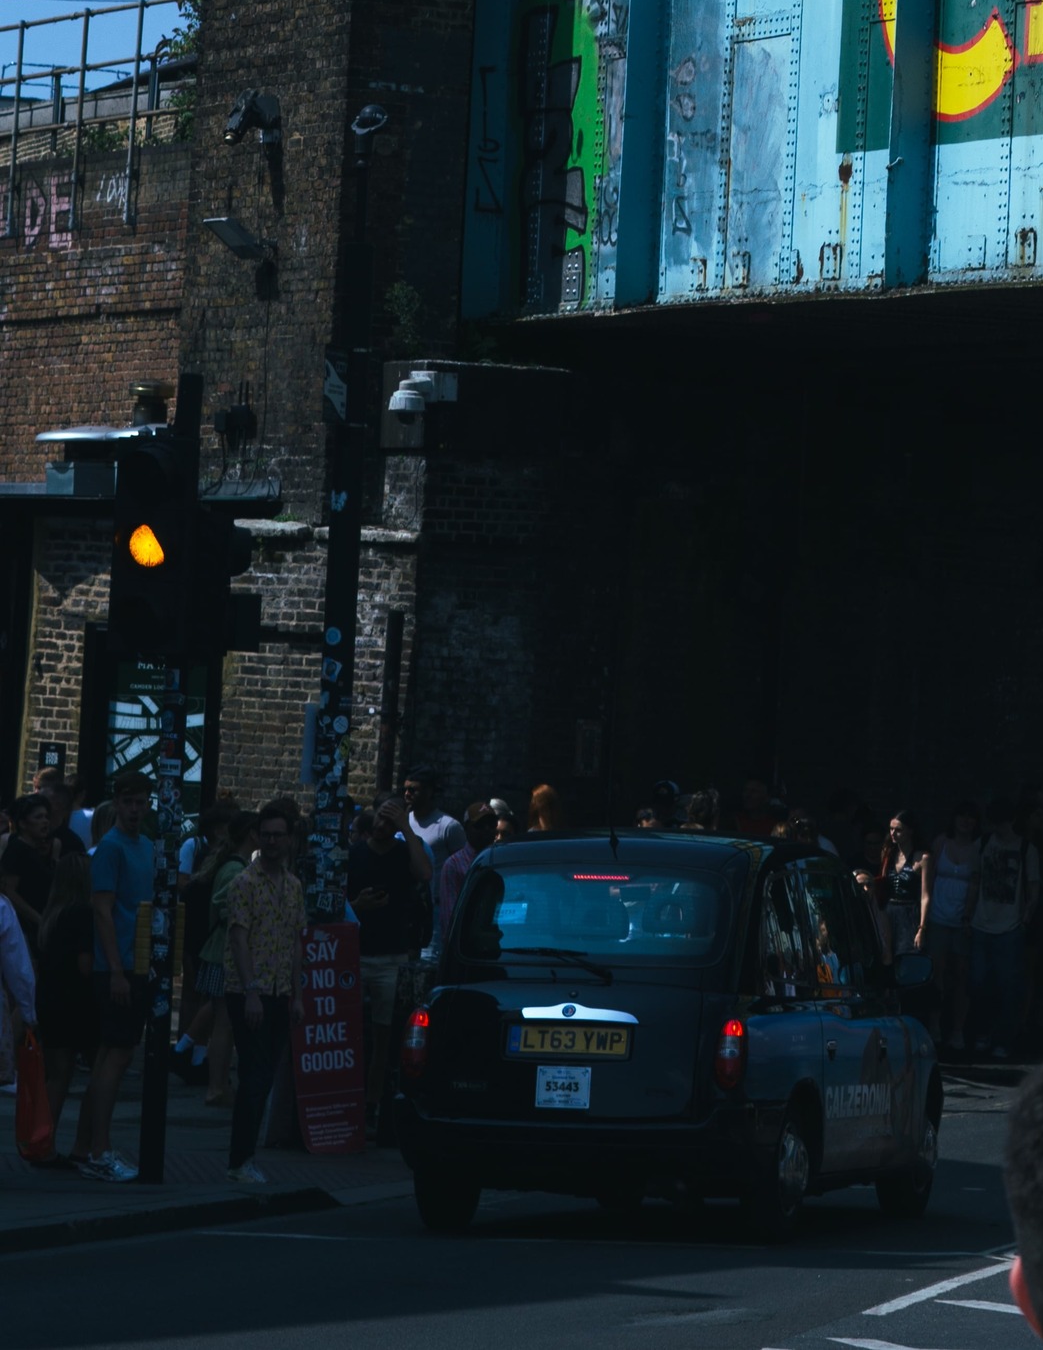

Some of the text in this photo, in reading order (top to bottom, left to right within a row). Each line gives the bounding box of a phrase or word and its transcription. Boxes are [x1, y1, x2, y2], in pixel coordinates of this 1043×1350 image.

[305, 938, 339, 963] SAY
[311, 967, 335, 989] NO
[313, 995, 336, 1017] TO
[304, 1021, 347, 1046] FAKE
[522, 1028, 623, 1052] LT63 YWP
[301, 1048, 355, 1074] GOODS
[545, 1081, 579, 1093] 53443
[824, 1082, 892, 1119] CALZEDONIA
